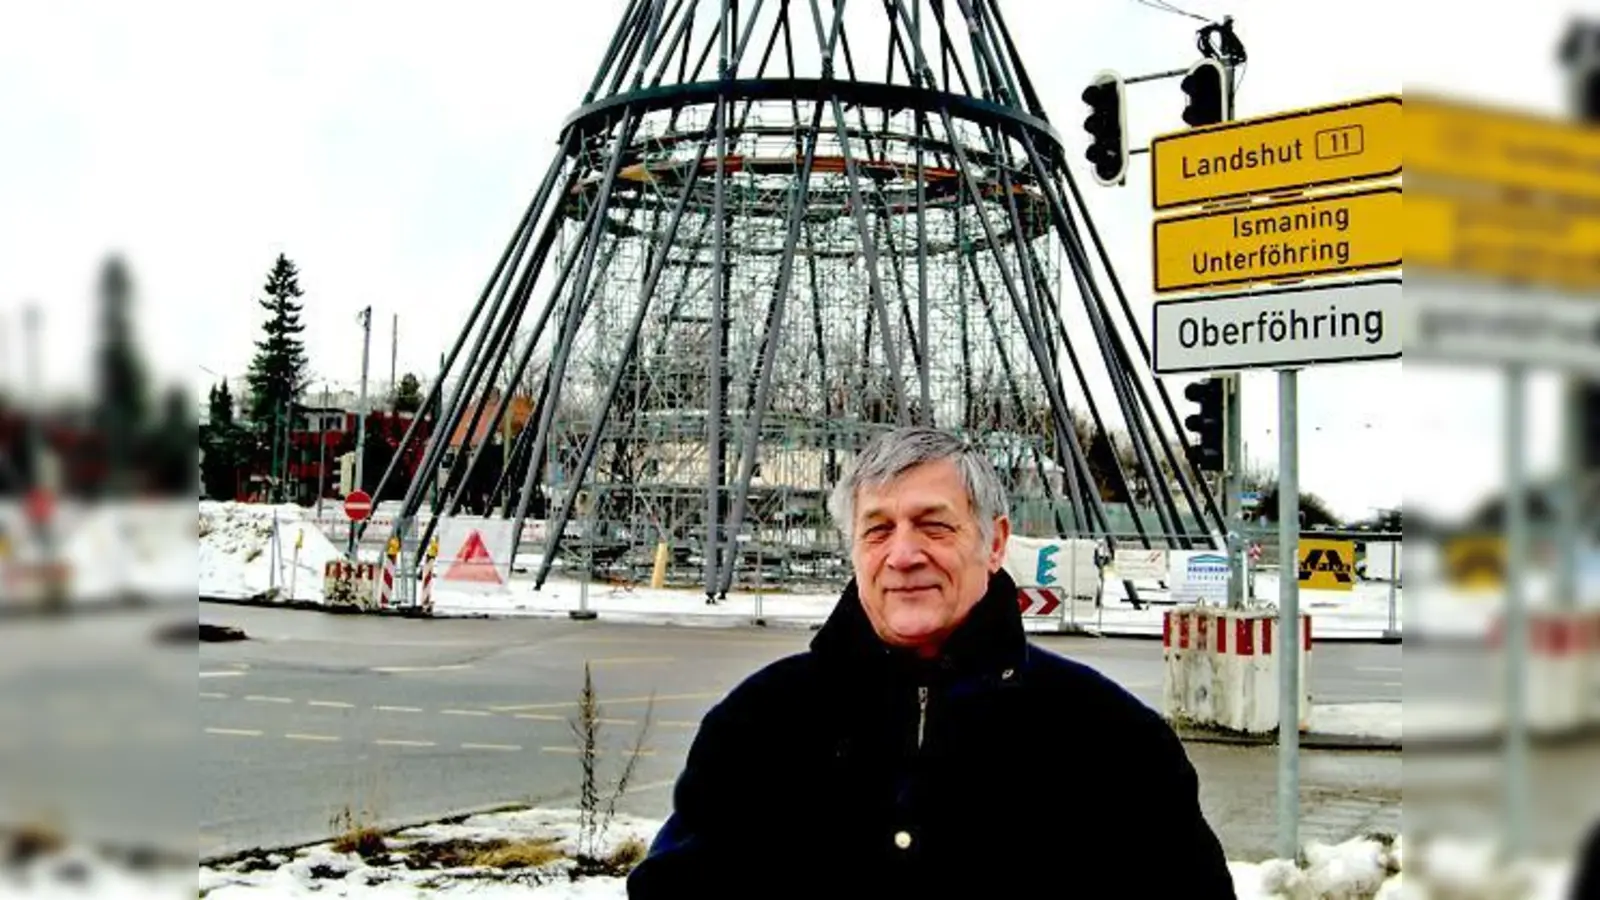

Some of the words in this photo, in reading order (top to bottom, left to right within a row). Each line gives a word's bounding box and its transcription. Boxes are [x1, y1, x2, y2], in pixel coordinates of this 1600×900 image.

[1182, 139, 1303, 179] Landshut
[1330, 132, 1350, 153] 11
[1233, 206, 1350, 238] Ismaning
[1193, 240, 1350, 275] Unterföhring
[1178, 305, 1384, 349] Oberföhring
